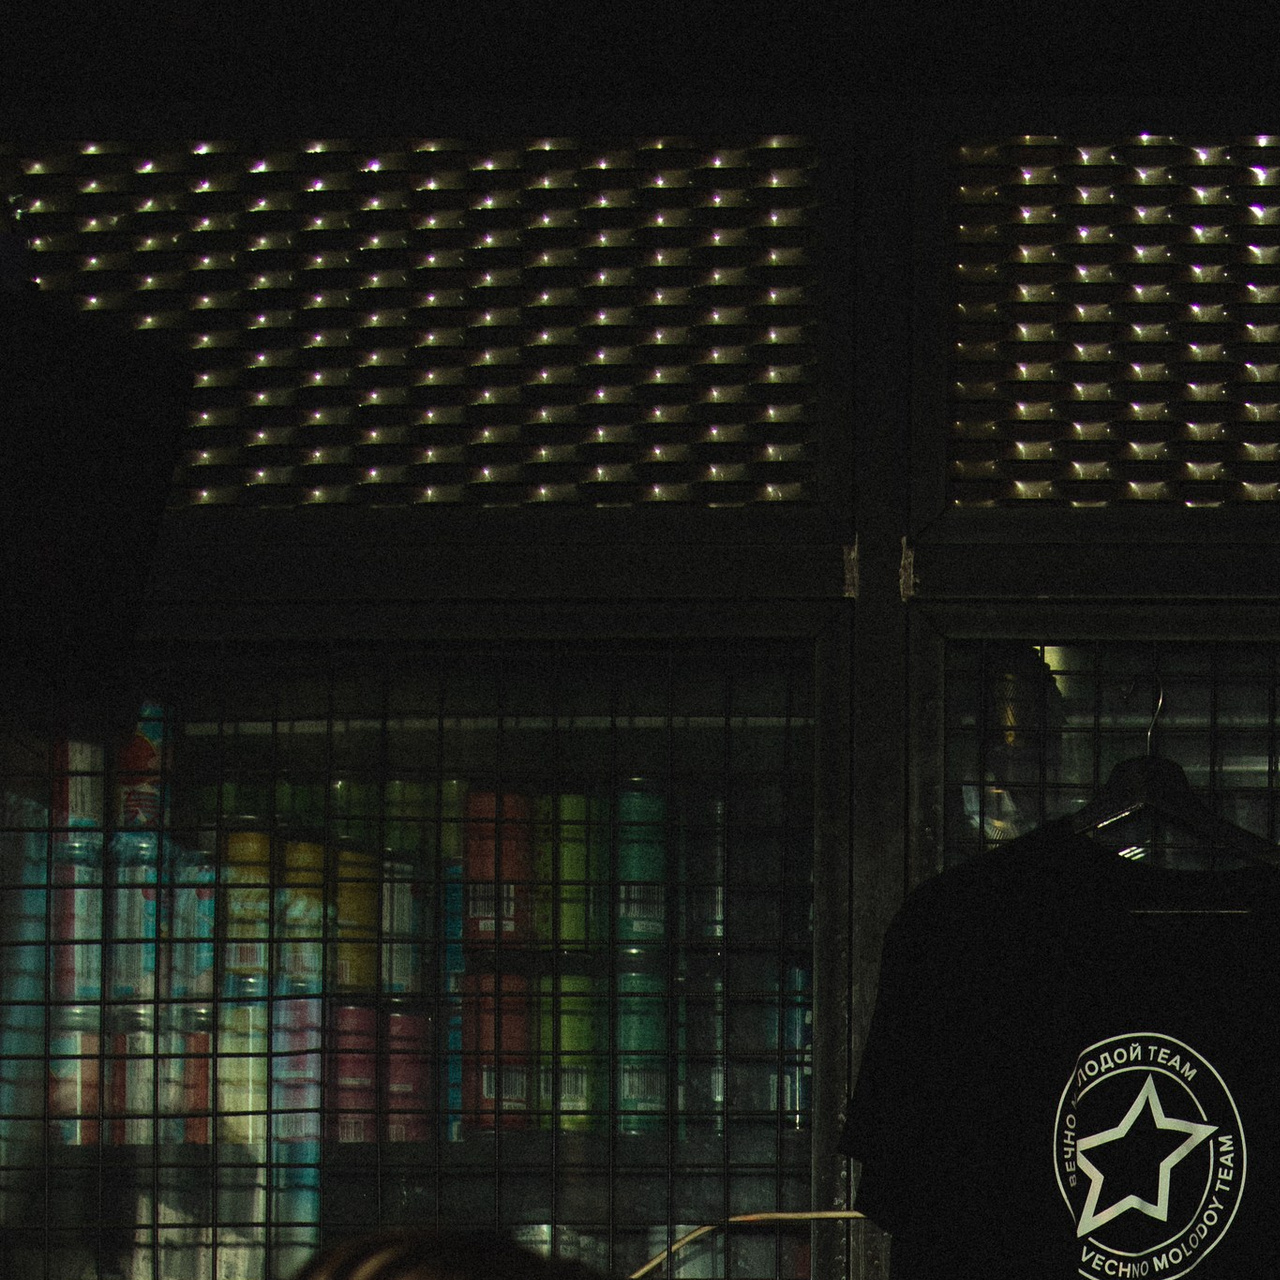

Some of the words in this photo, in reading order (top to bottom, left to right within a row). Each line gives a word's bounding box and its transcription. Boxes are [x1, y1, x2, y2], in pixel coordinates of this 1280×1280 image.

[1147, 1045, 1198, 1082] TEAM
[1080, 1245, 1149, 1279] VECHNO
[1152, 1196, 1225, 1273] MOLODOY
[1214, 1134, 1234, 1193] TEAM
